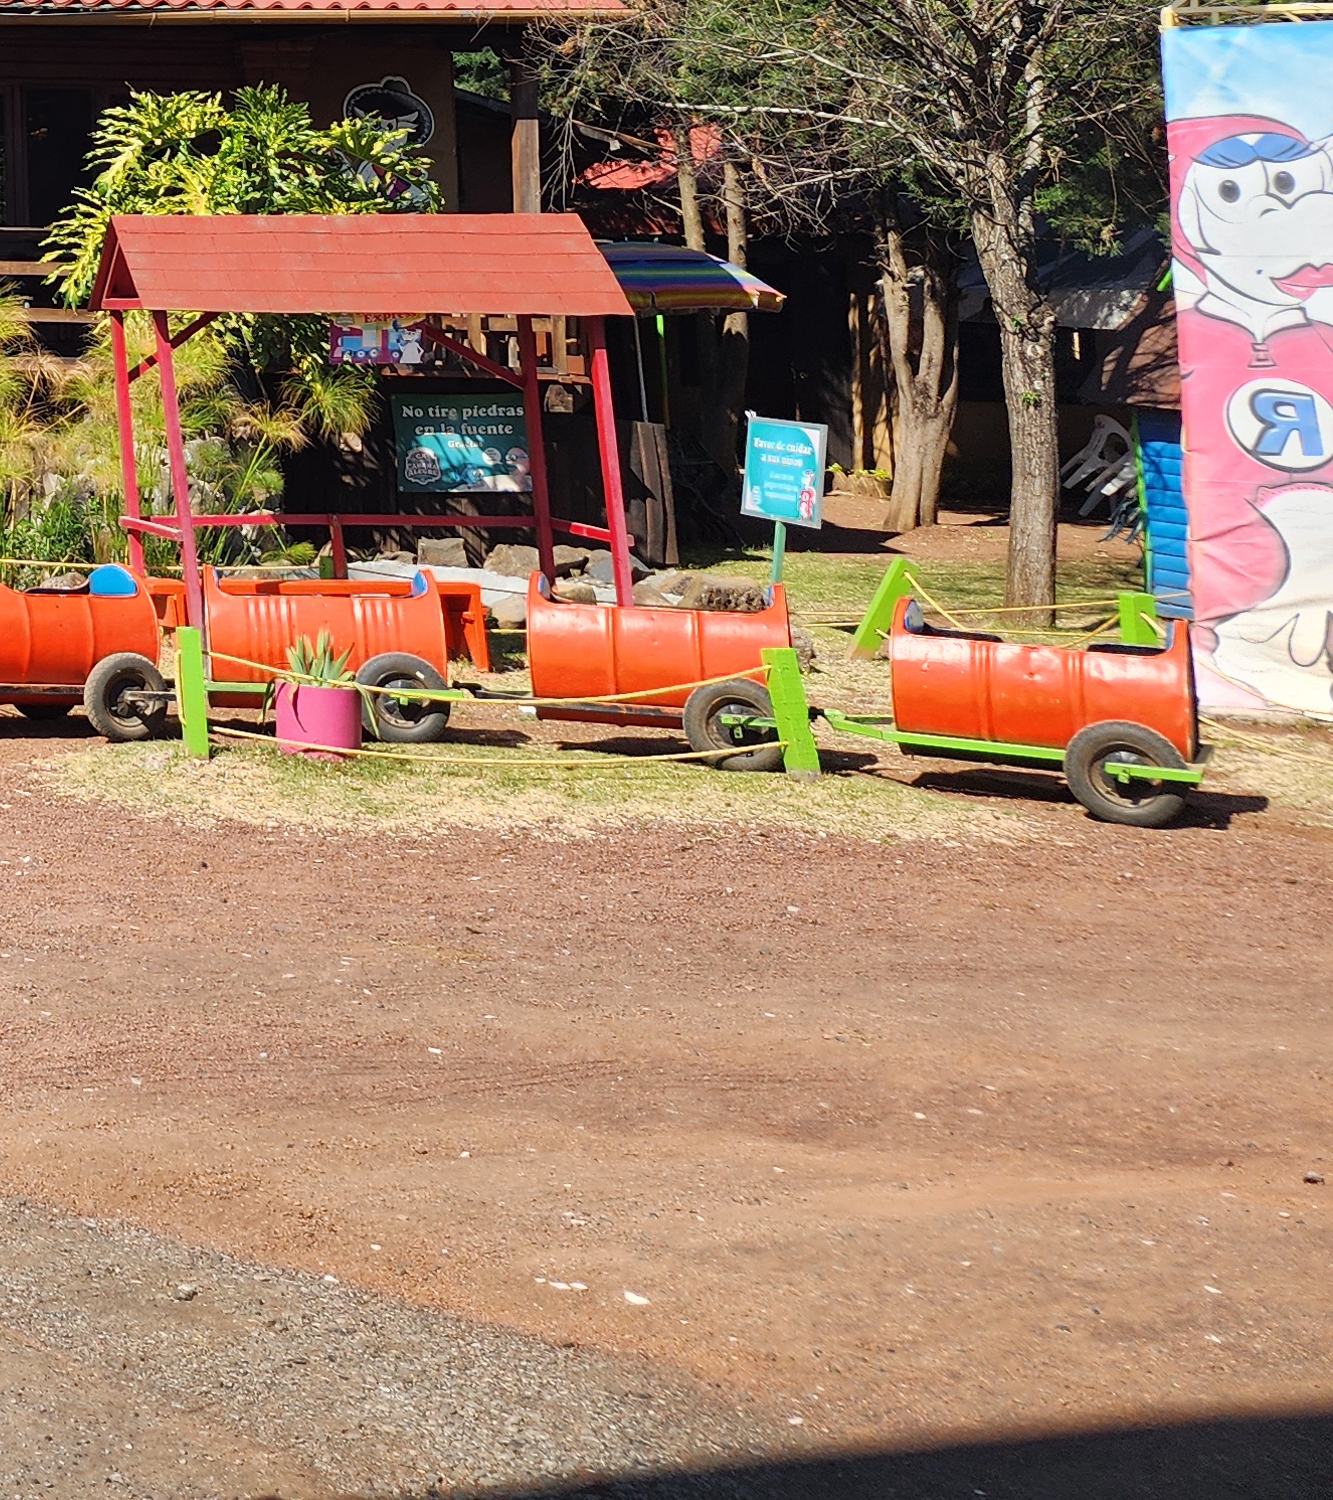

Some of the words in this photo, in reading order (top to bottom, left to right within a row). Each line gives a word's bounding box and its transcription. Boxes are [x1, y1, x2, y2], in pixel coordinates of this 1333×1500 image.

[402, 405, 424, 418] No
[428, 405, 458, 419] tire
[463, 404, 524, 419] piedras
[415, 426, 435, 435] en
[441, 423, 455, 435] la
[461, 423, 514, 435] fuente
